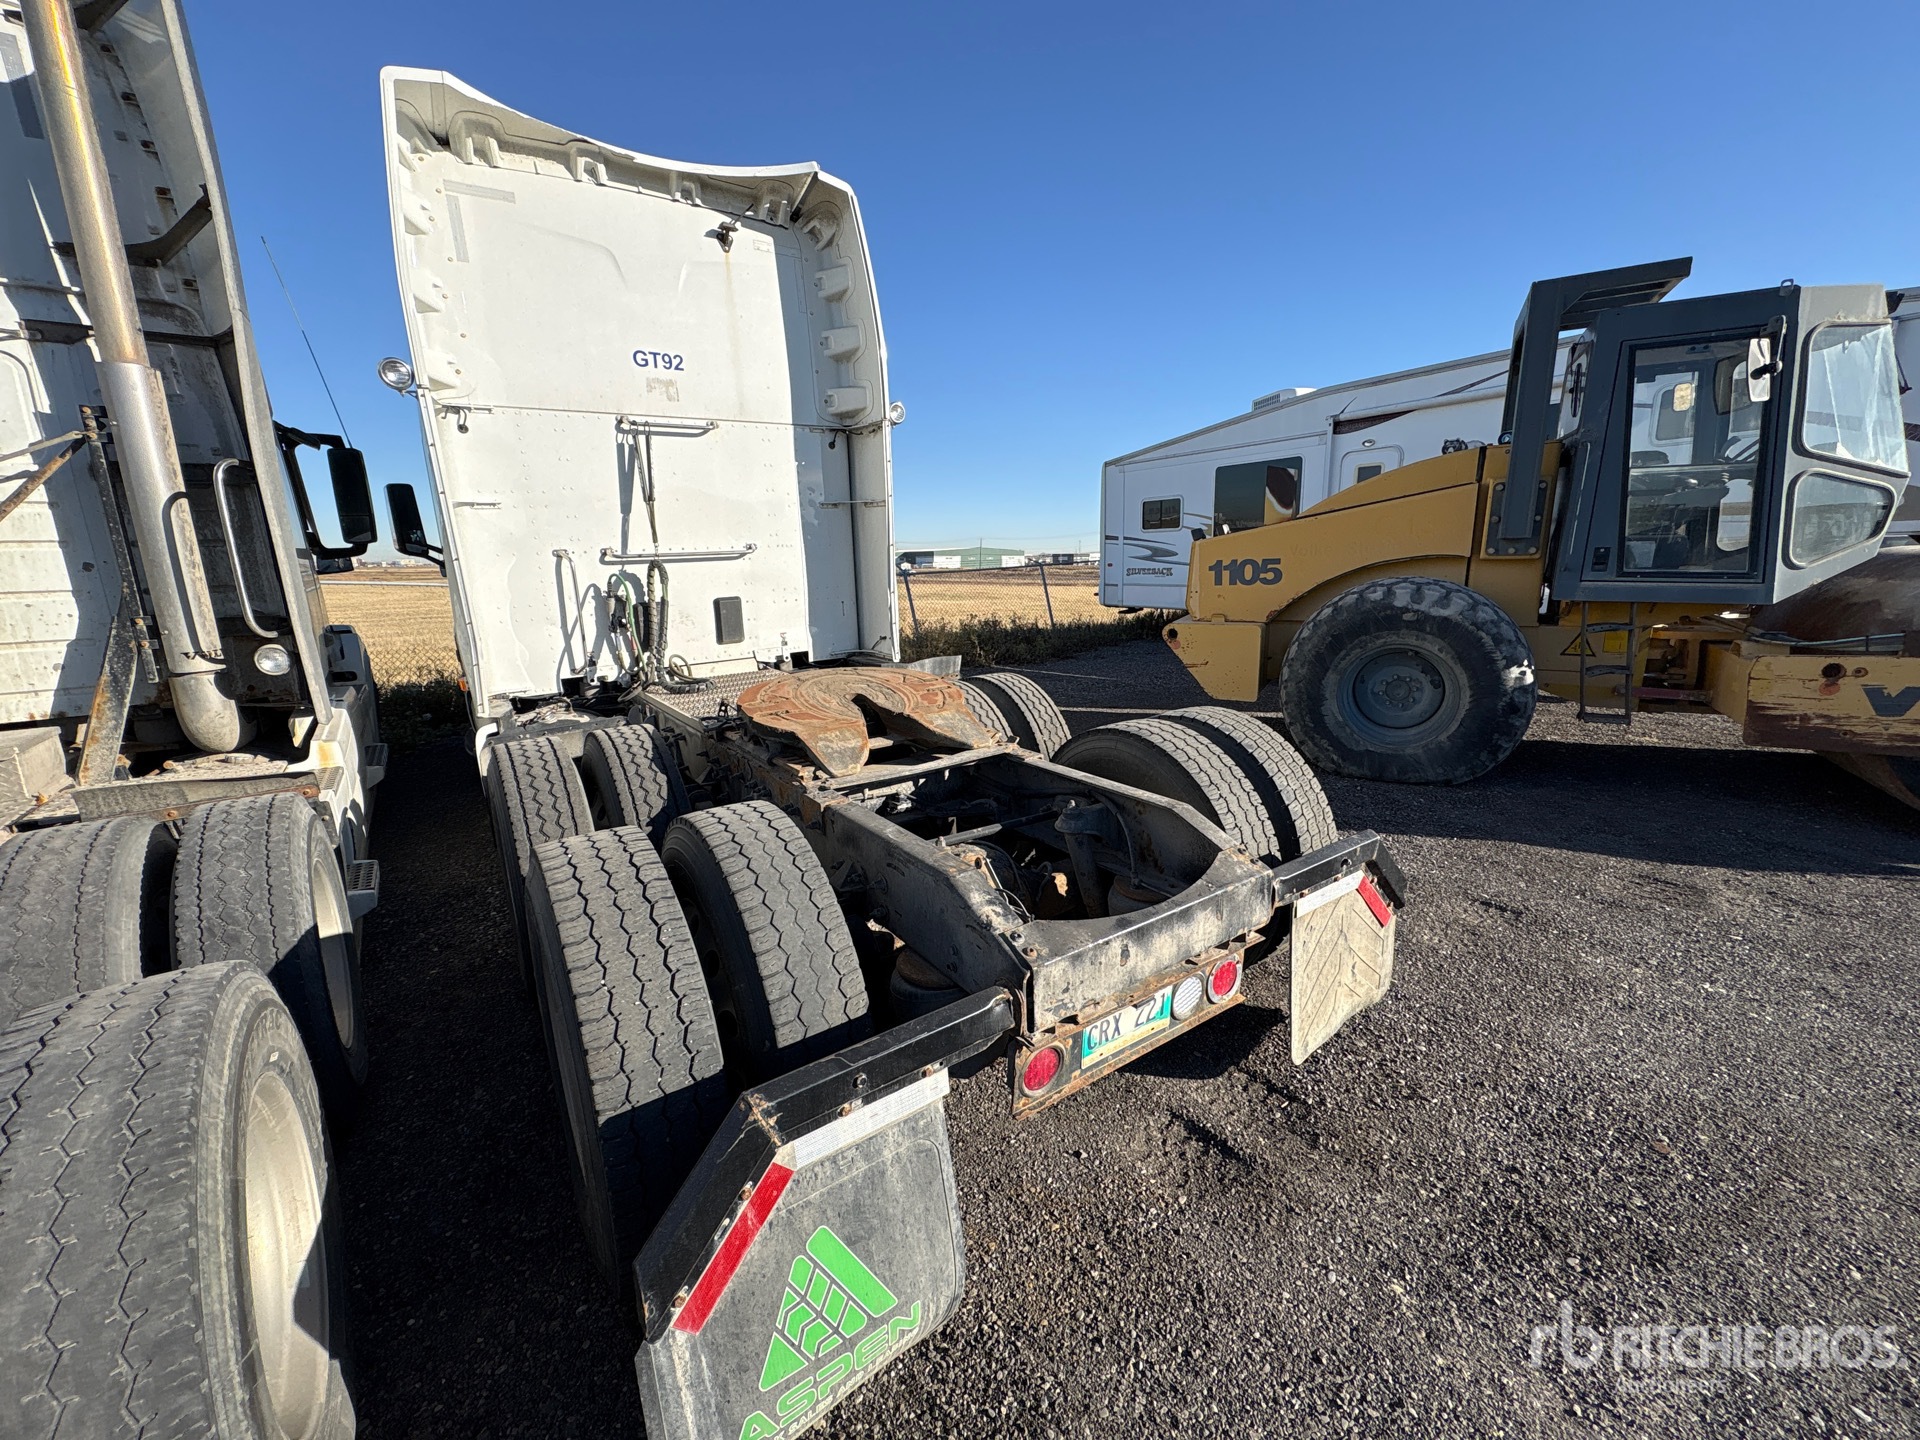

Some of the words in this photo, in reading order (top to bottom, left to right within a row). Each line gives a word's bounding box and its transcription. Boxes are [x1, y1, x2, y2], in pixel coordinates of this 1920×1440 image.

[632, 350, 685, 371] GT92
[1126, 567, 1174, 577] SILVERBACK
[1208, 558, 1283, 586] 1105
[1087, 1012, 1122, 1051] CRX
[1134, 993, 1165, 1028] 221
[738, 1300, 920, 1440] ASPEN
